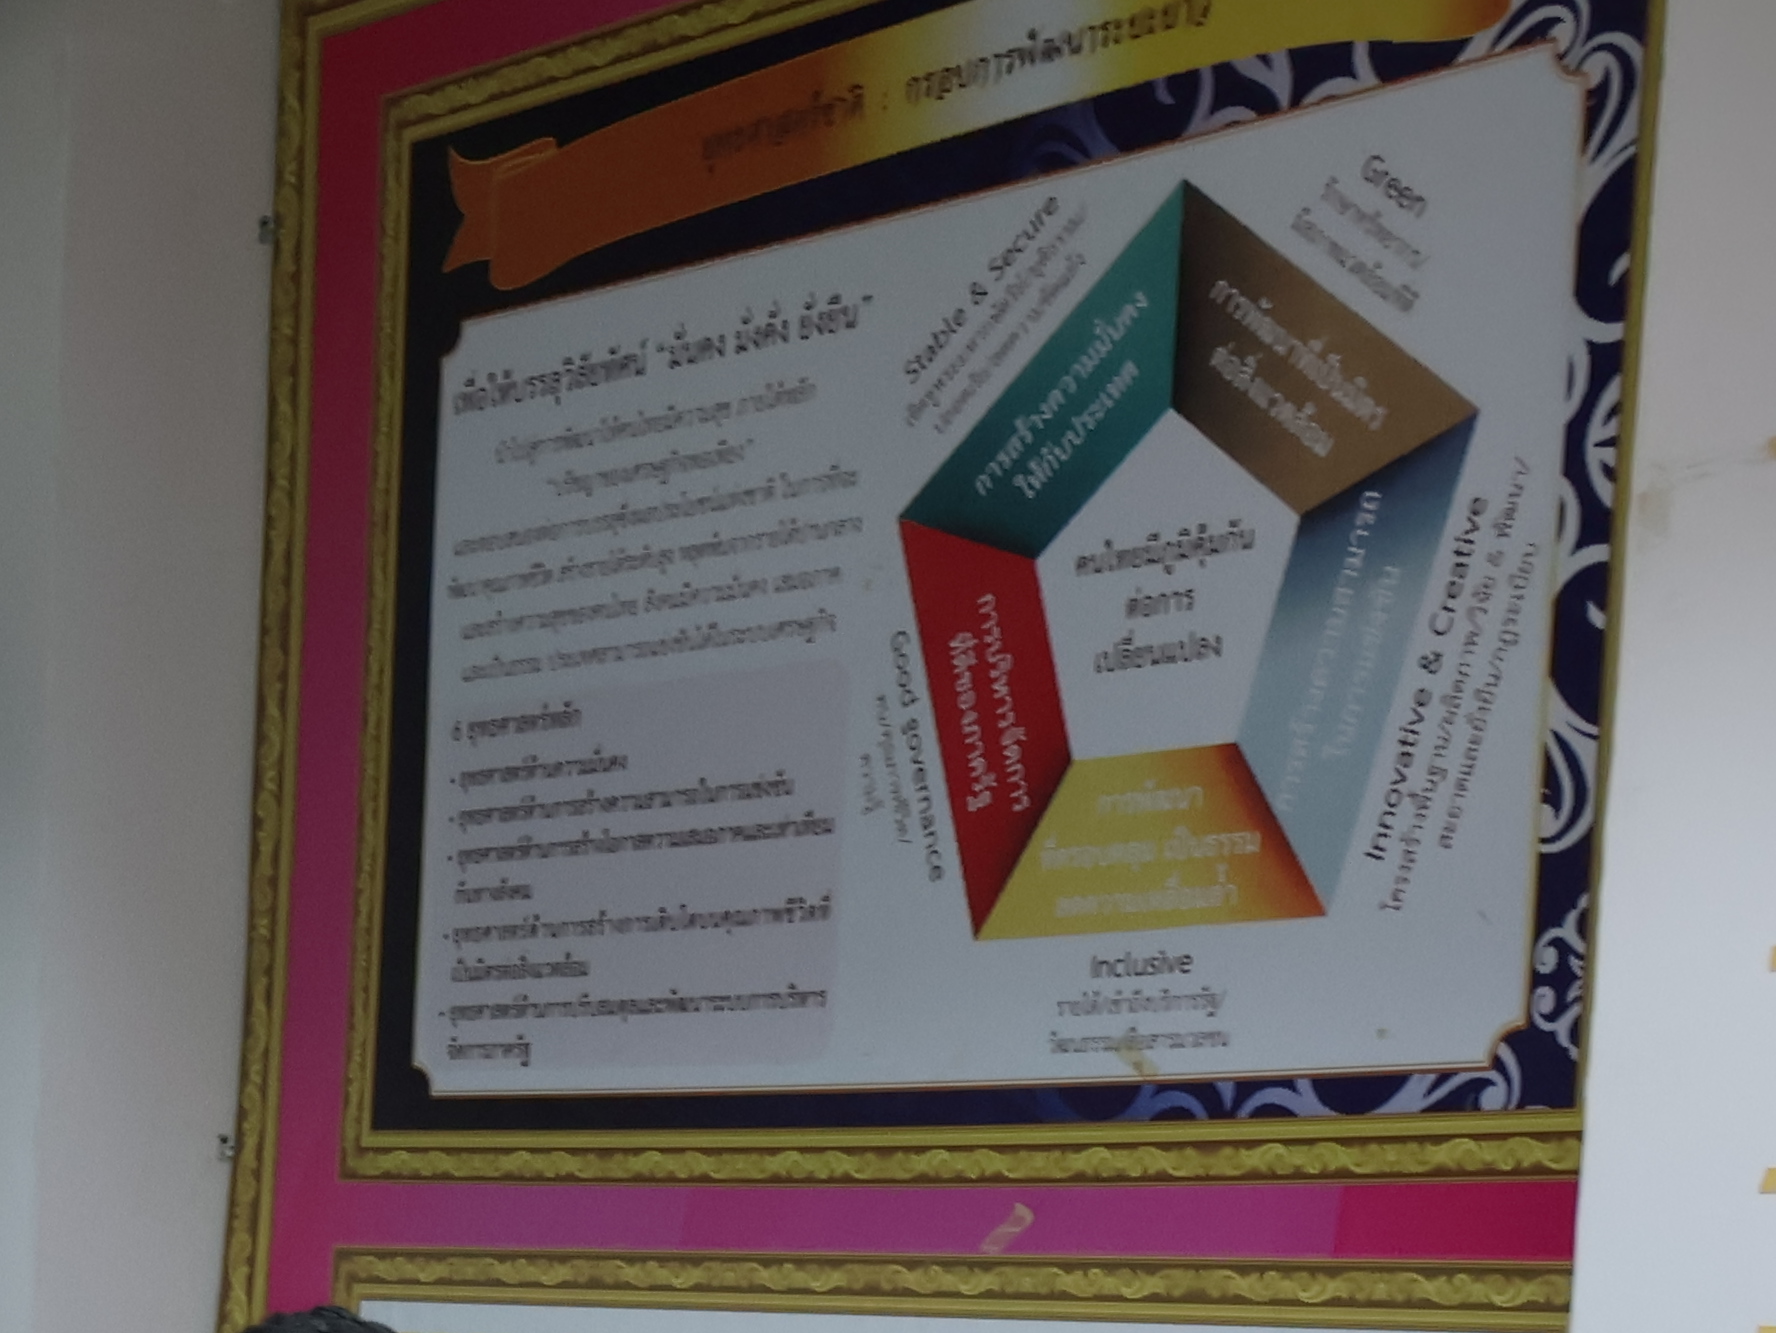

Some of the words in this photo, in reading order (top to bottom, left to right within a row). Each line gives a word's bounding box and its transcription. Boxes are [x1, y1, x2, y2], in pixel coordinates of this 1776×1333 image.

[889, 628, 919, 709] Good
[1364, 684, 1429, 861] Innovative
[1428, 497, 1490, 640] Creative
[900, 716, 945, 884] governance
[1089, 950, 1193, 981] Inclusive
